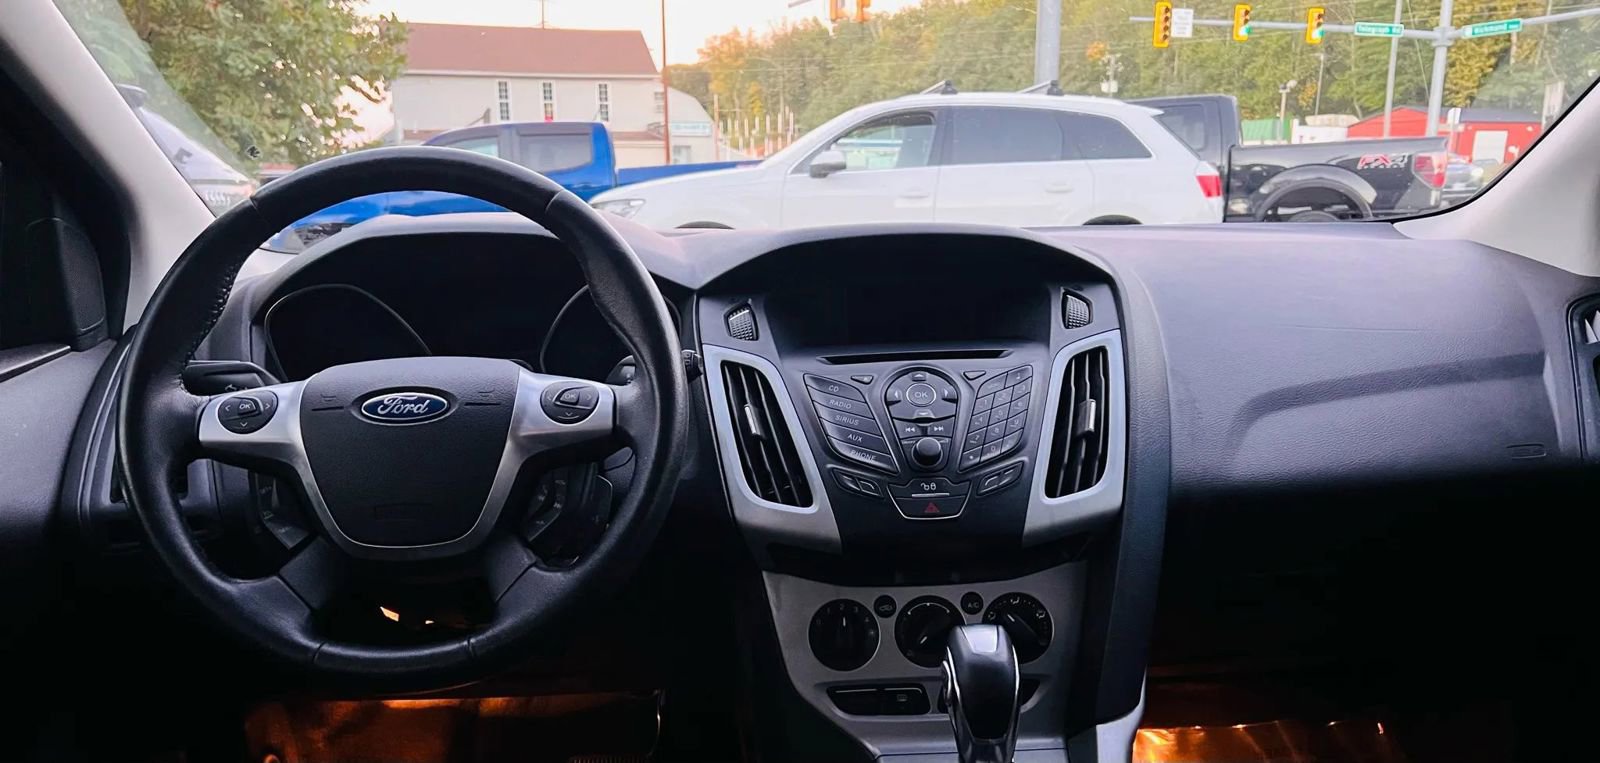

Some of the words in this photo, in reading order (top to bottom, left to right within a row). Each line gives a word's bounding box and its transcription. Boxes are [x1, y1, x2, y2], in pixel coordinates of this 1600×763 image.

[1357, 152, 1408, 168] FX4
[239, 402, 252, 410] OK
[377, 396, 429, 415] Ford
[829, 399, 852, 409] RADIO
[835, 414, 859, 426] SIRIUS
[847, 433, 862, 442] AUX
[850, 449, 877, 461] PHONE
